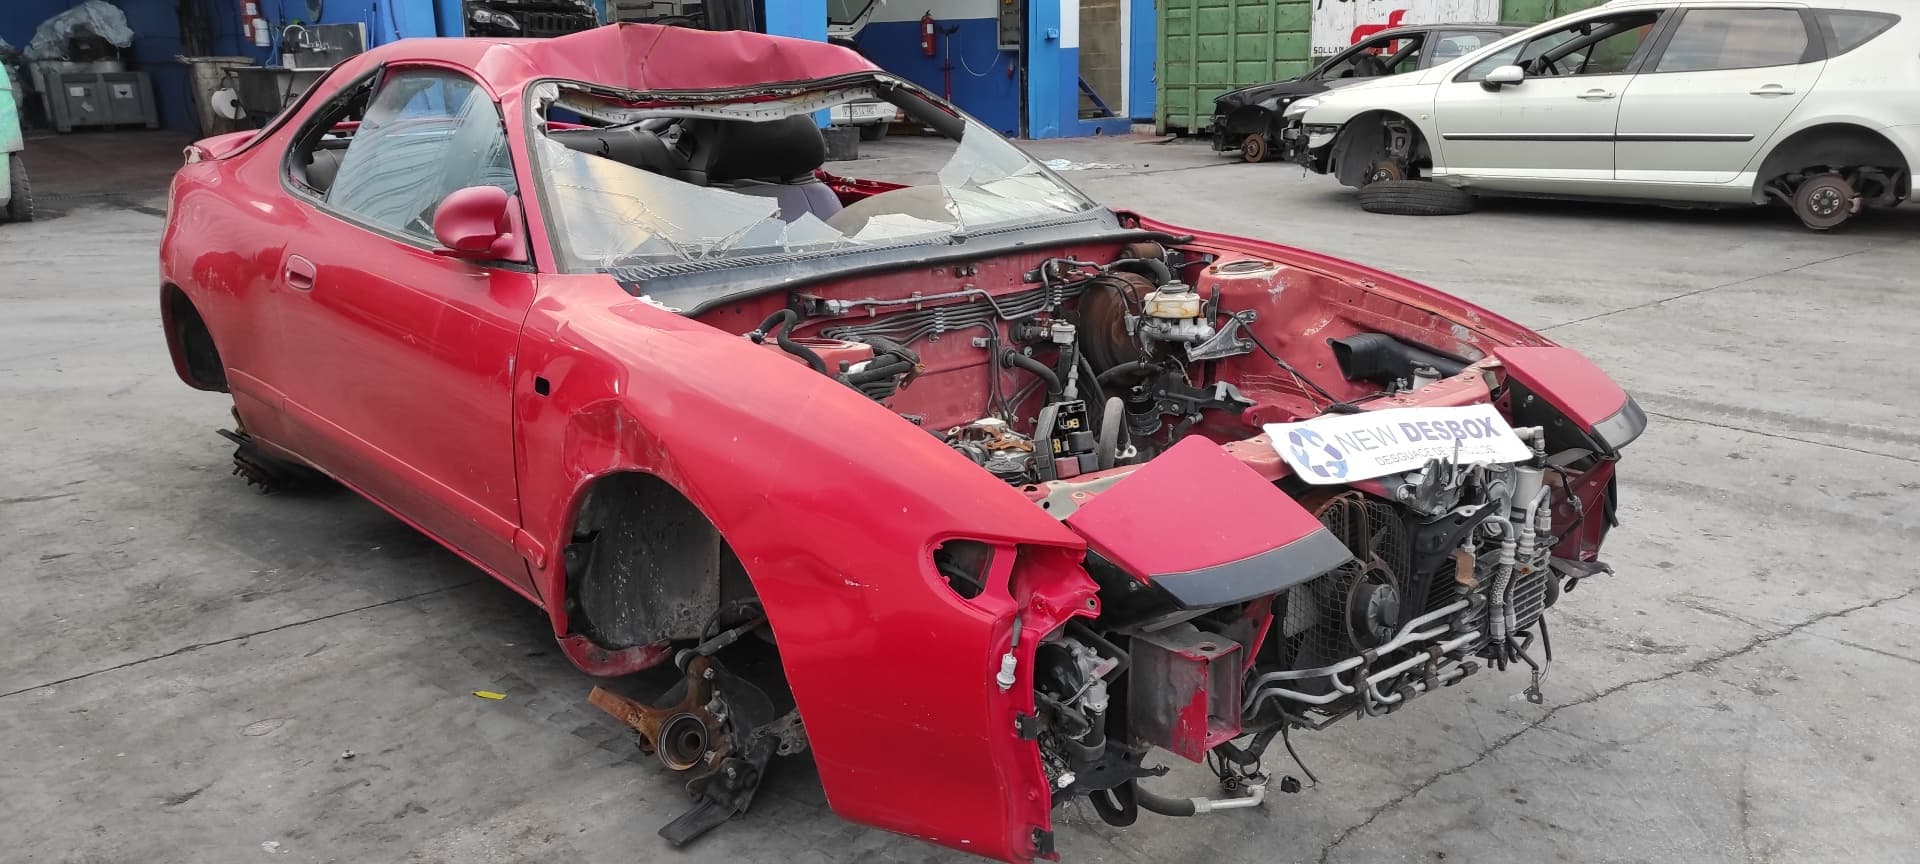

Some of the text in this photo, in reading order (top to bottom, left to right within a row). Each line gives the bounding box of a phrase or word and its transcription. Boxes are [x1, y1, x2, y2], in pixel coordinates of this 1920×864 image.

[1313, 46, 1349, 54] SOLLAN
[1334, 416, 1502, 454] NEW DESBOX
[1374, 447, 1432, 466] DESGUACE
